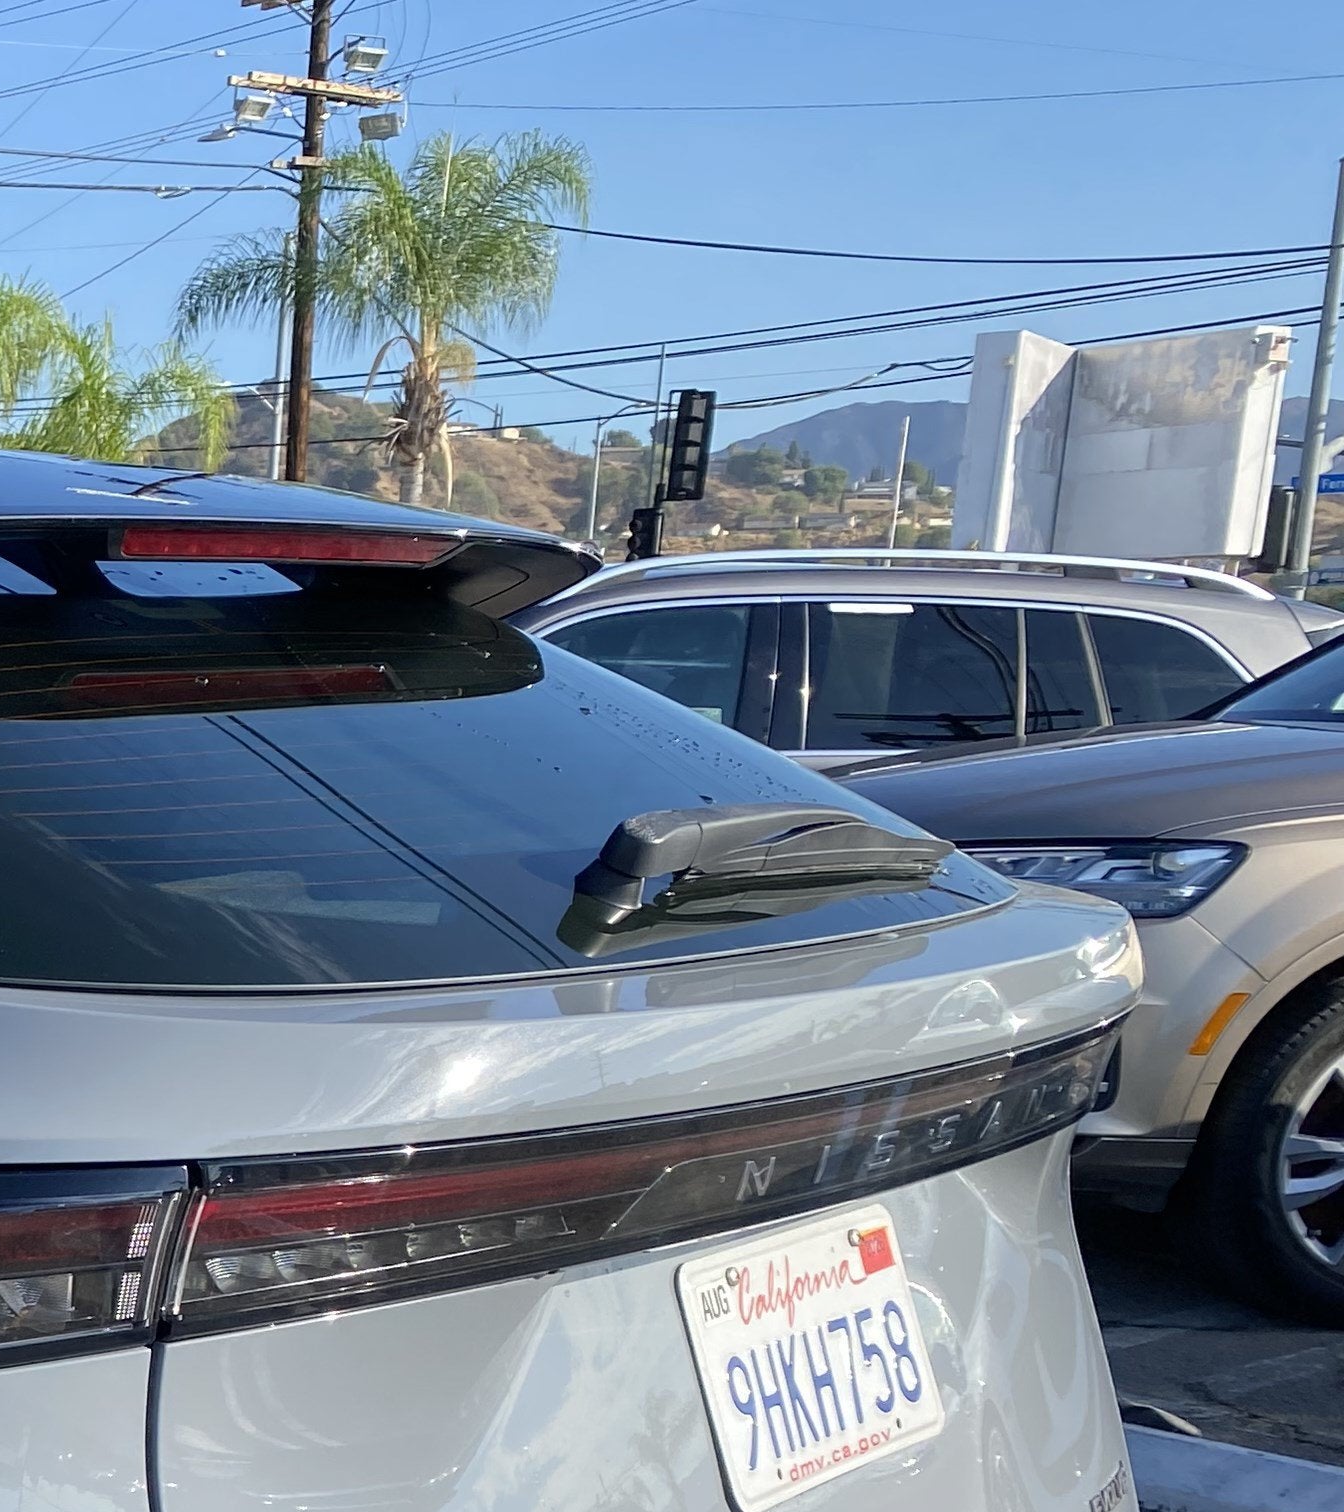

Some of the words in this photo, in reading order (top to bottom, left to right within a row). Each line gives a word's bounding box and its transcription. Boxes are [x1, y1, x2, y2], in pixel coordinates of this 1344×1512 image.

[735, 1084, 1049, 1201] NISSAN
[700, 1284, 731, 1322] AUG
[735, 1254, 868, 1328] California
[726, 1300, 922, 1471] 9HKH758
[789, 1427, 892, 1482] dmv.ca.gov
